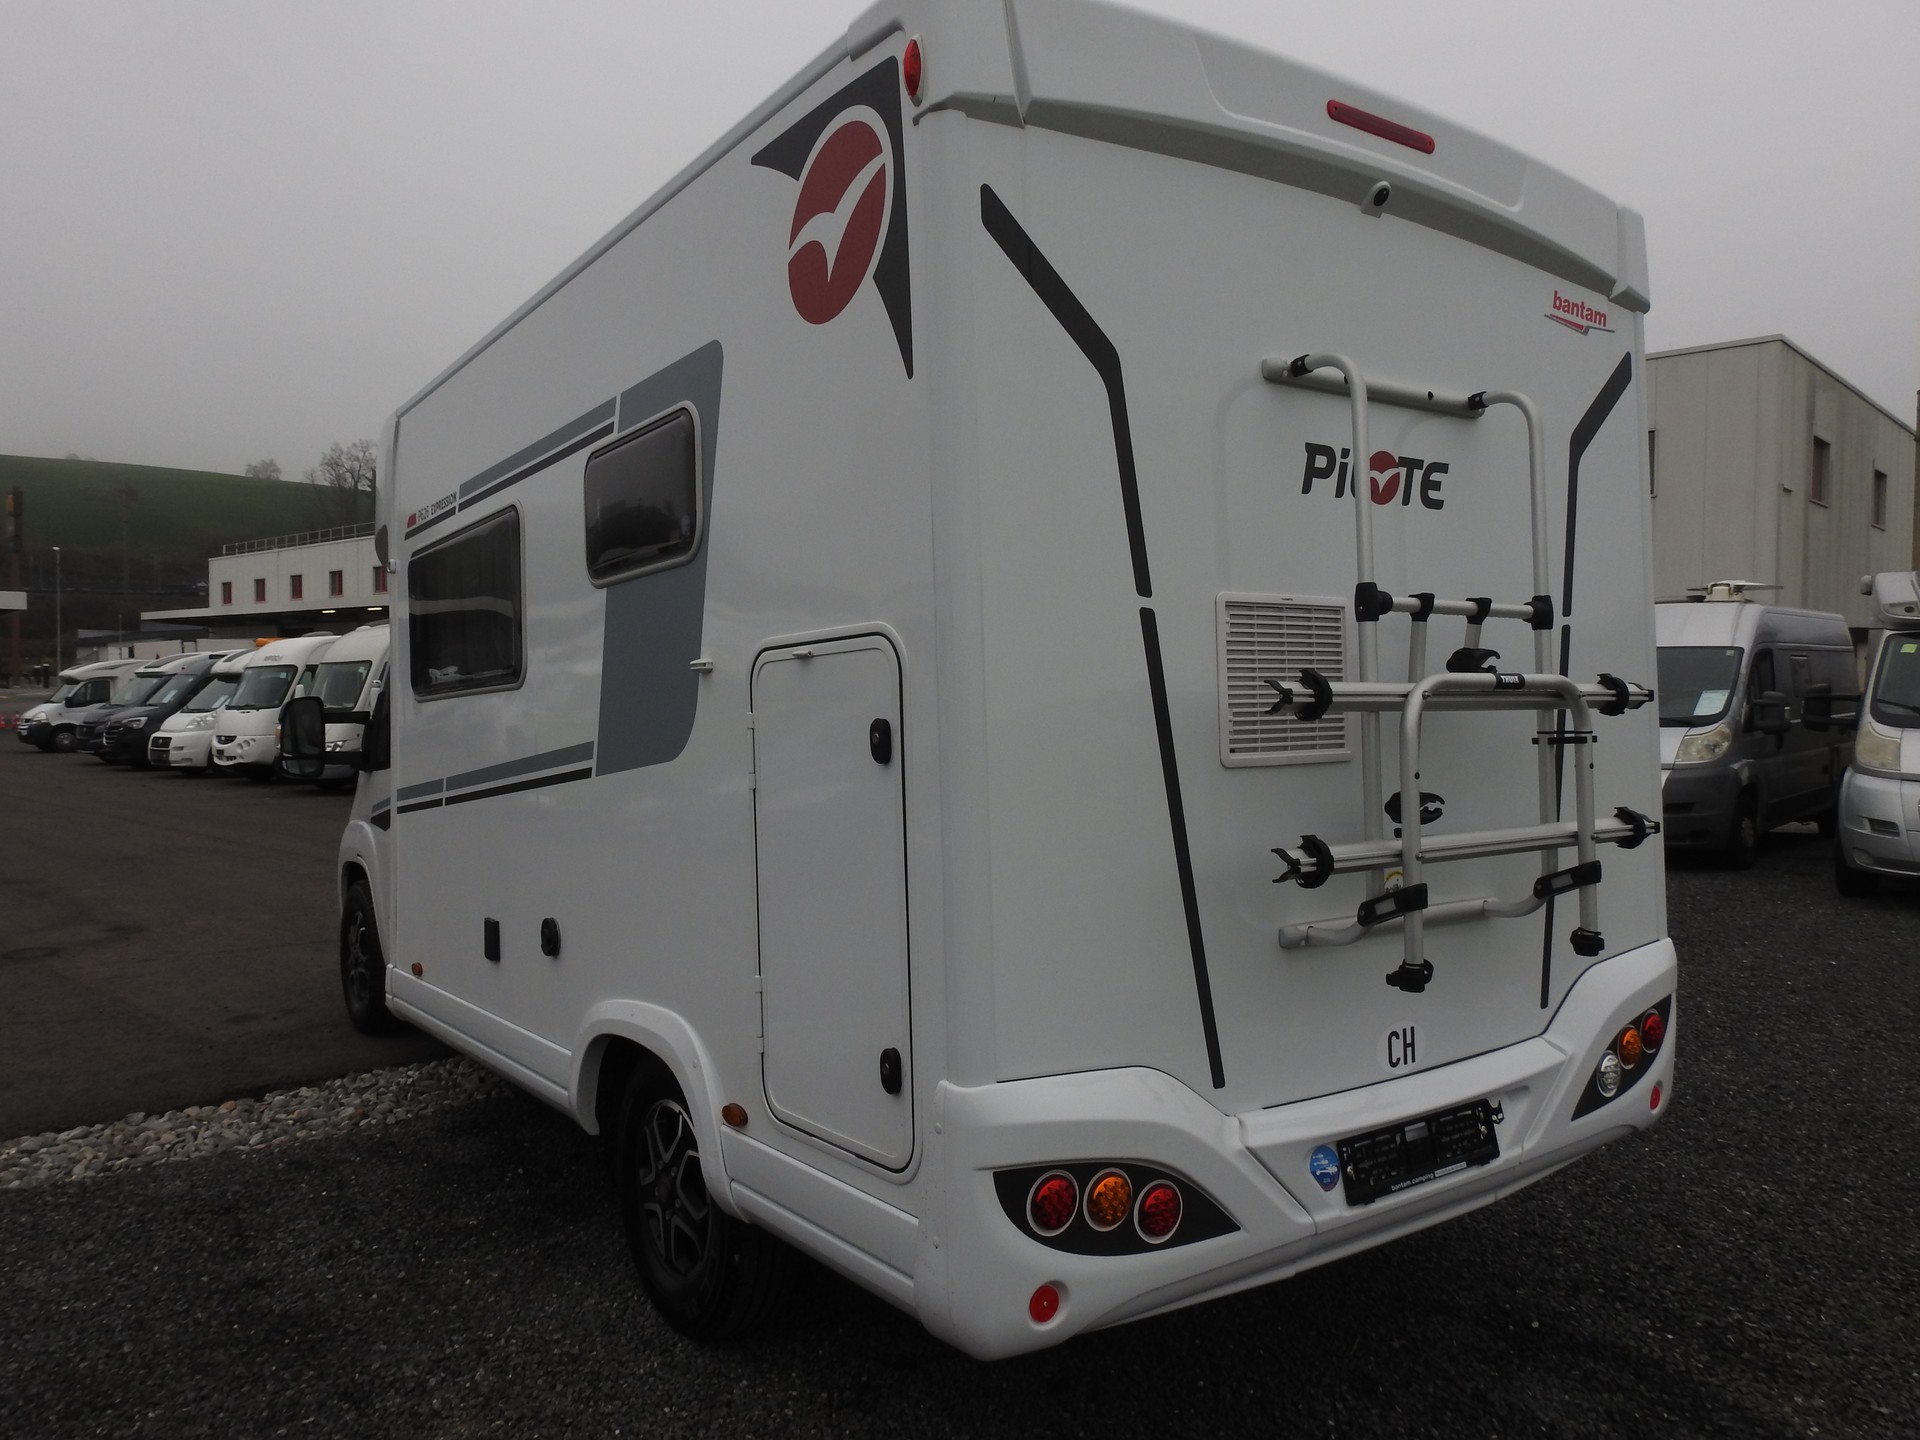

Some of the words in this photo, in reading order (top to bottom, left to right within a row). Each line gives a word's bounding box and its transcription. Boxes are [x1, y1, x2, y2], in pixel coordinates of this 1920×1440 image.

[1552, 290, 1607, 327] bantam
[1301, 442, 1450, 511] PiOTE
[431, 492, 457, 516] EXPRESSION
[1387, 1026, 1416, 1068] CH
[1391, 1180, 1412, 1191] bantam
[1411, 1173, 1434, 1184] camping
